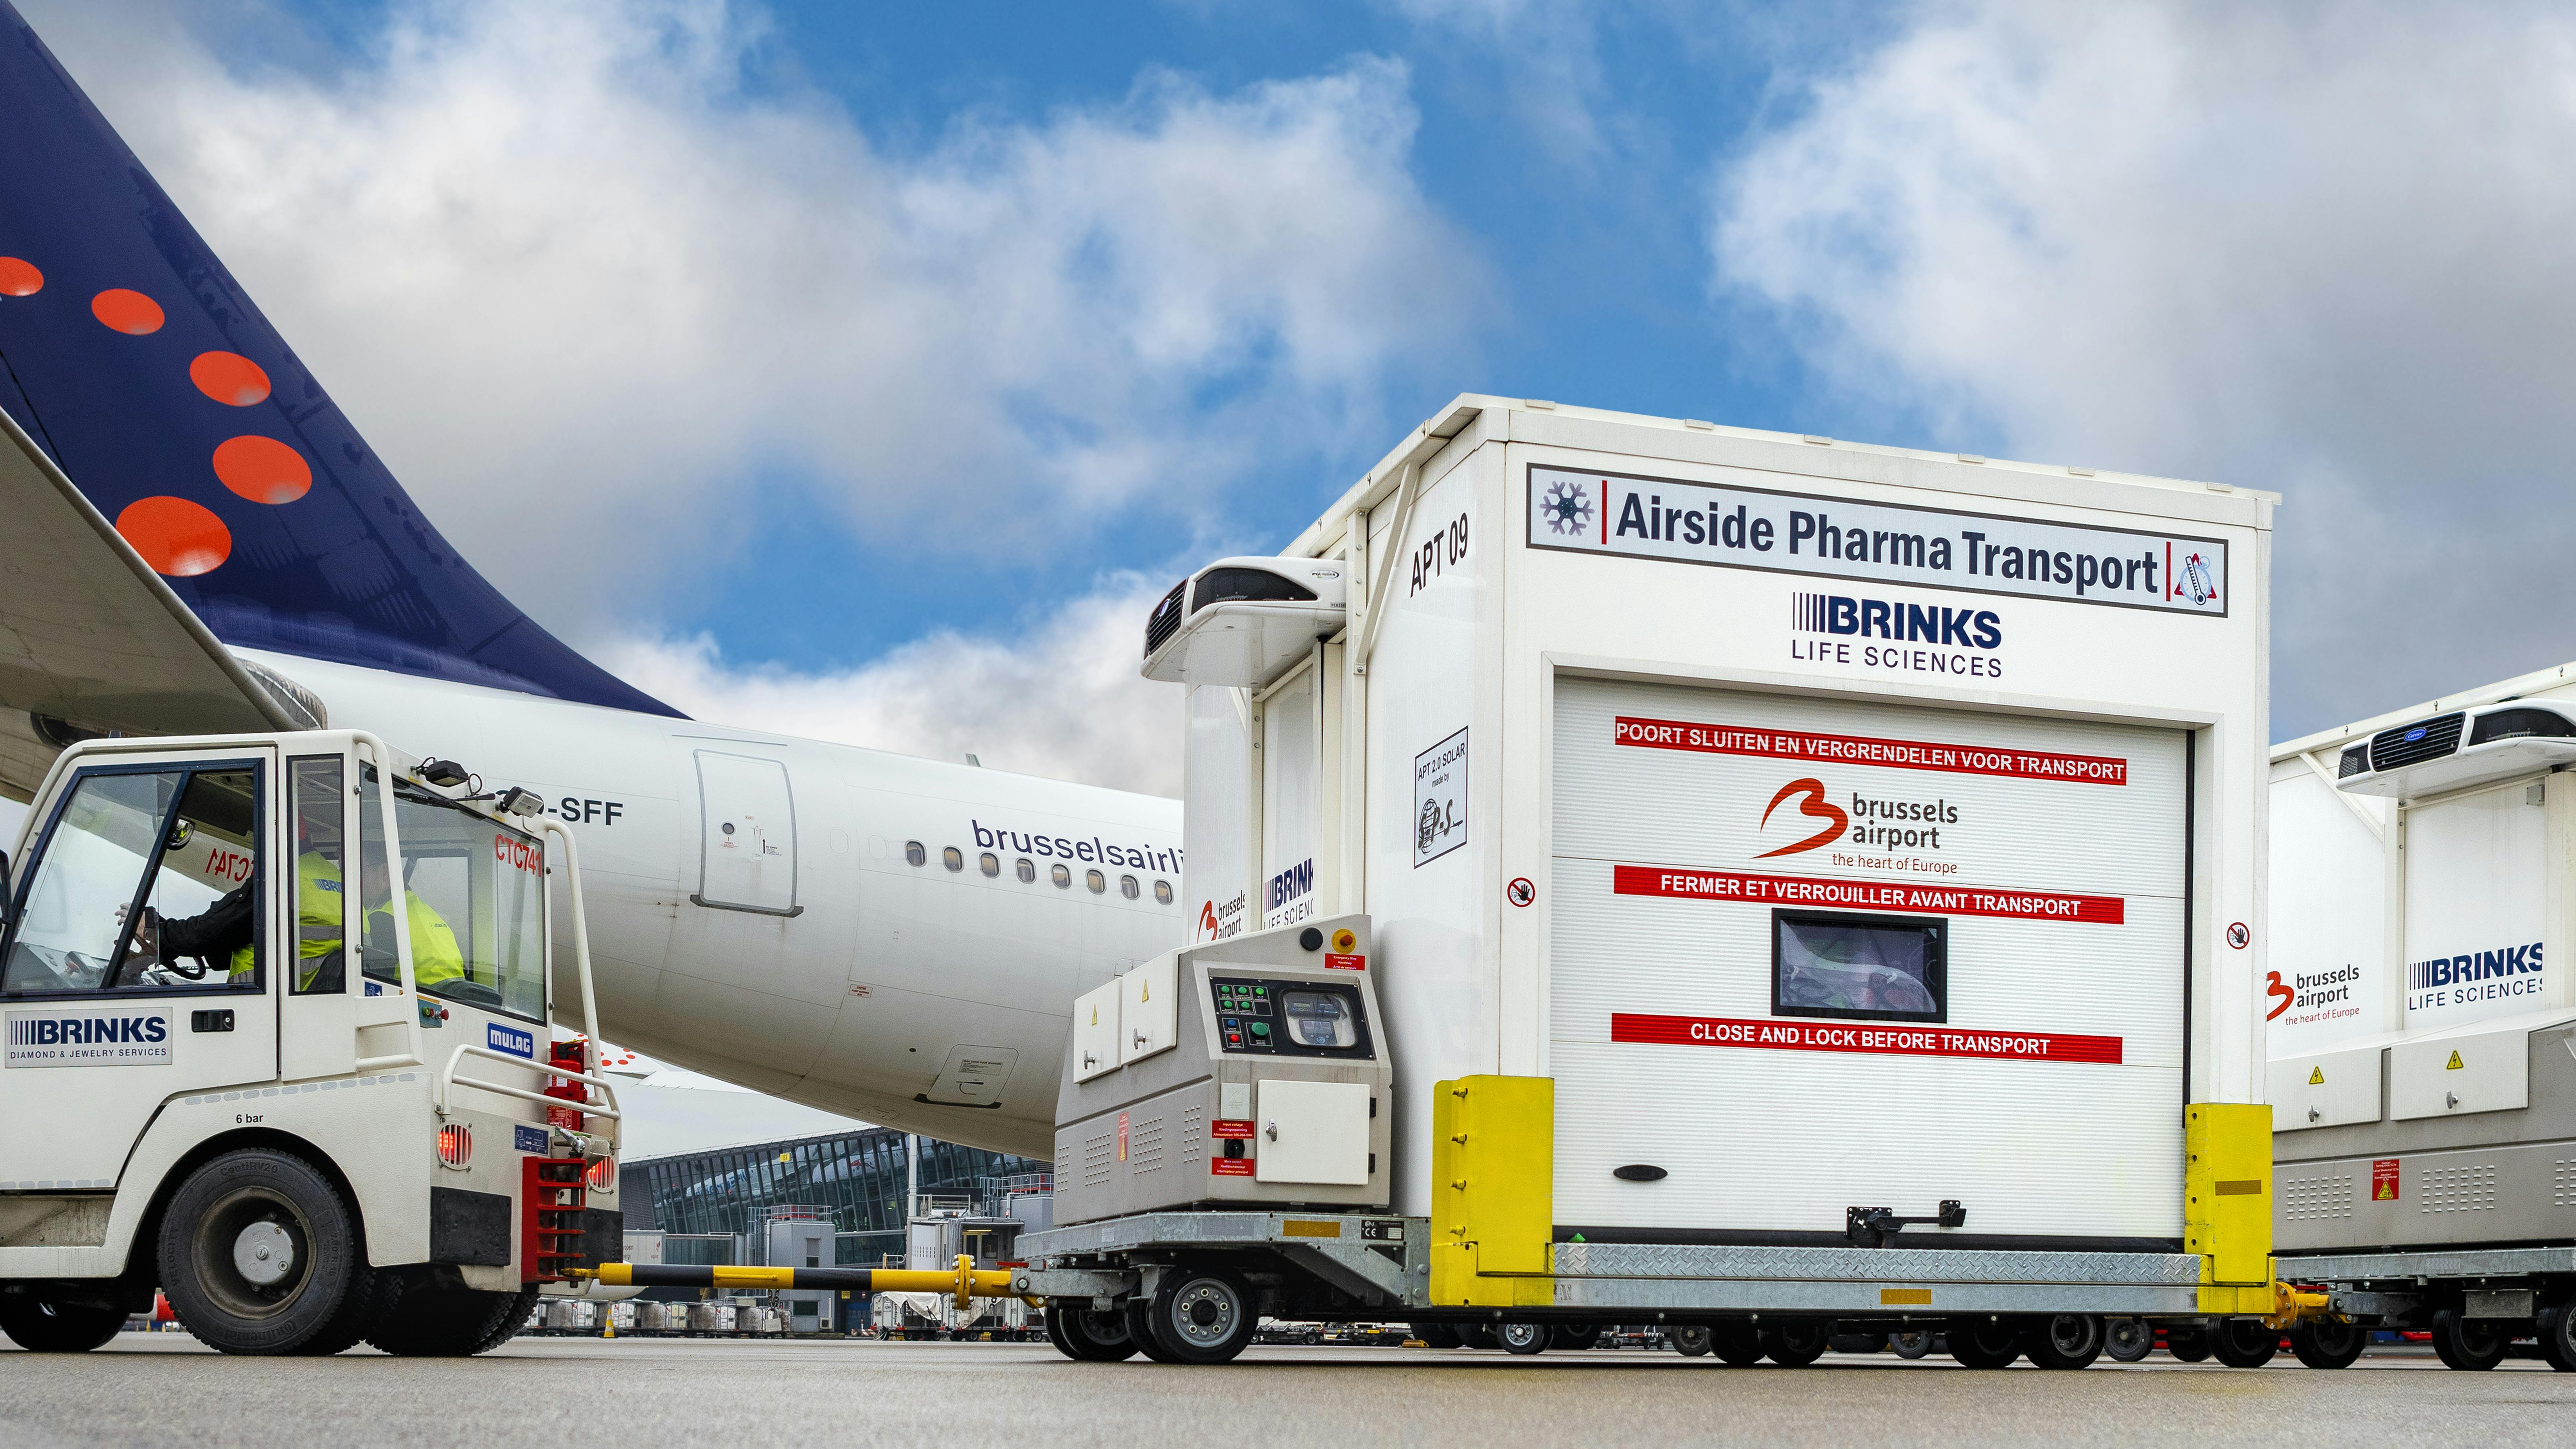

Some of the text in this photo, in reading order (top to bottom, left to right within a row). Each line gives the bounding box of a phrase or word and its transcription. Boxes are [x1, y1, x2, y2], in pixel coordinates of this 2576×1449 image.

[1410, 512, 1468, 598] APT 09
[1616, 492, 2158, 596] Airside Pharma Transport
[1828, 595, 2002, 649] BRINKS
[1792, 639, 2002, 678] LIFE SCIENCES
[1418, 742, 1465, 781] APT 2.0 SOLAR
[1616, 723, 2125, 779] POORT SLUITEN EN VERGRENDELEN VOOR TRANSPORT
[1432, 772, 1449, 788] made by
[1853, 792, 1958, 824] brussels
[1852, 820, 1940, 852] airport
[495, 834, 542, 878] CTC741
[1832, 853, 1958, 876] the heart of Europe
[1661, 874, 2082, 916] FERMER ET VERROUILLER AVANT TRANSPORT
[1218, 914, 1241, 940] airport
[2297, 964, 2359, 989] brussels
[2431, 942, 2543, 987] BRINKS
[2296, 985, 2349, 1009] airport
[2409, 992, 2445, 1011] LIFE
[37, 1016, 167, 1045] BRINKS
[2285, 1008, 2360, 1026] the heart of Europe
[10, 1050, 55, 1059] DIAMOND
[69, 1049, 114, 1058] JEWELRY
[118, 1048, 167, 1057] SERVICES
[490, 1029, 530, 1053] MULAG
[1690, 1023, 2051, 1054] CLOSE AND LOCK BEFORE TRANSPORT
[236, 1114, 264, 1124] 6 bar
